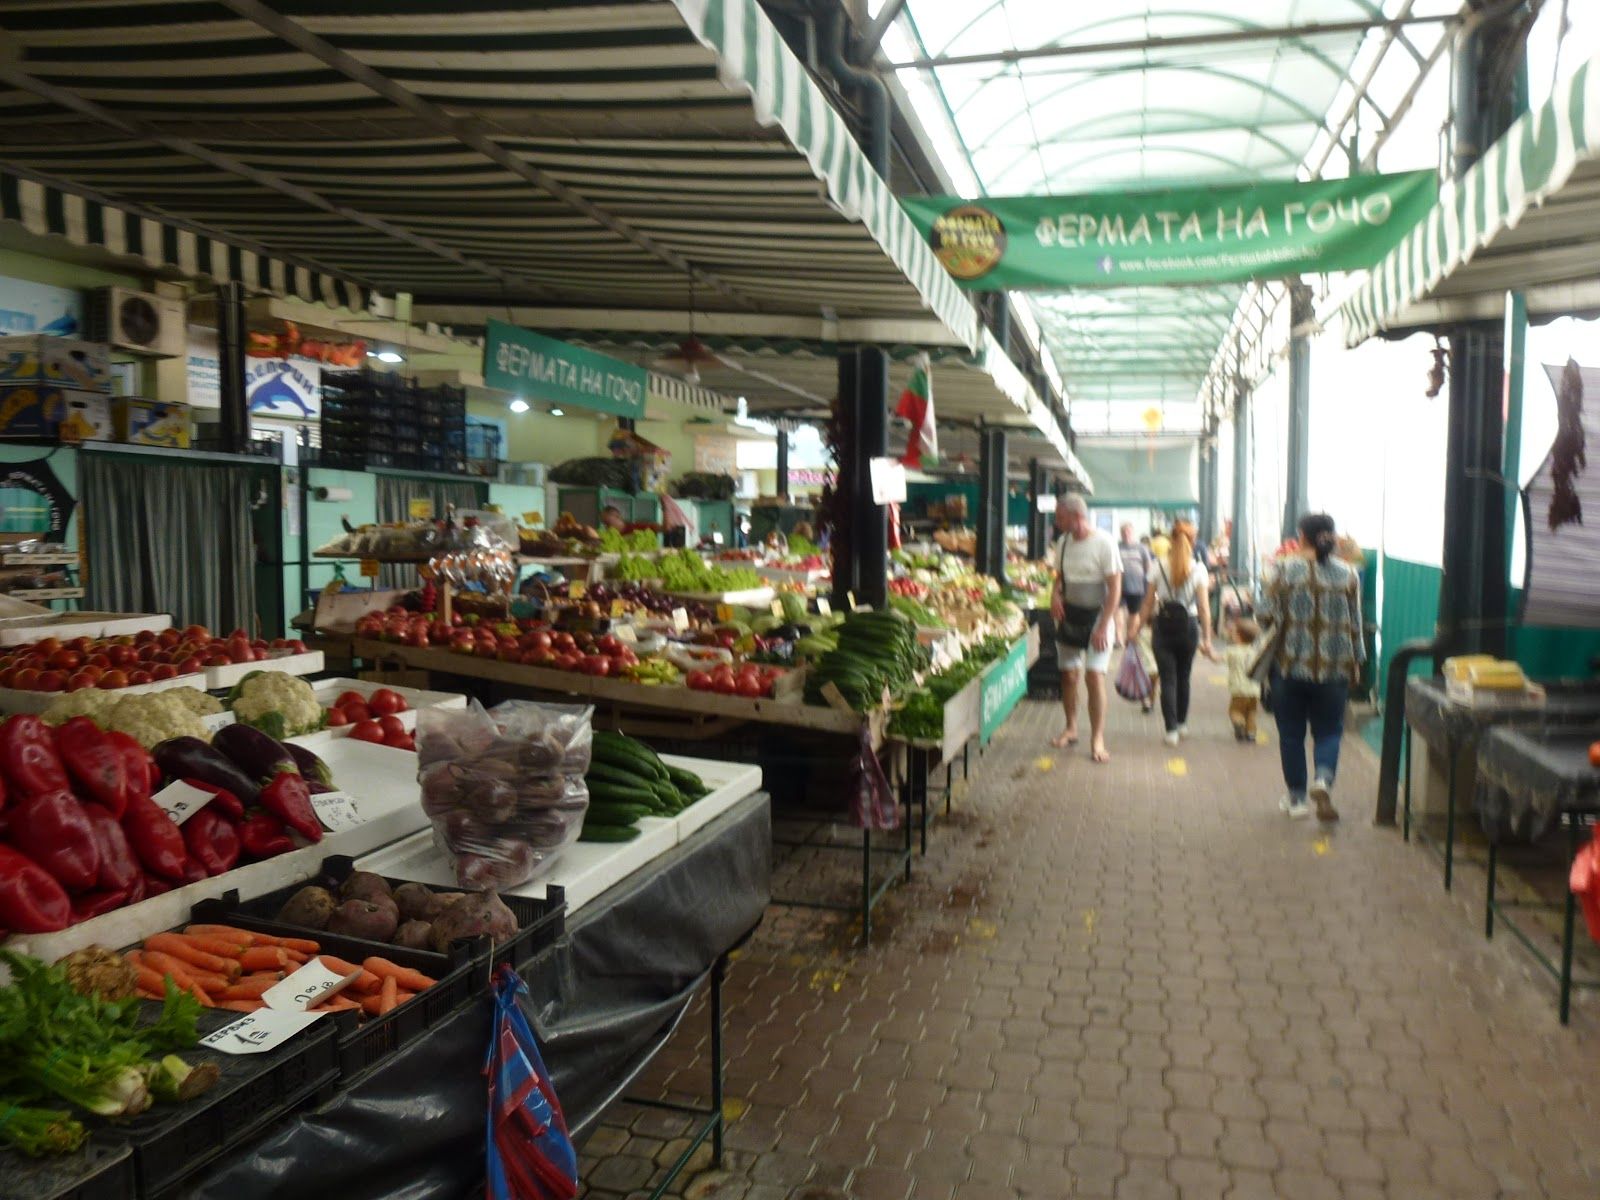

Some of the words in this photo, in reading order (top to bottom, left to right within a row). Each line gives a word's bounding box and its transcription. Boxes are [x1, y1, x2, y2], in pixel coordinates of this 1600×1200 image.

[1035, 211, 1204, 248] ФЕРМАТА
[1216, 204, 1270, 242] НА
[1284, 191, 1392, 237] ГОЧО
[495, 342, 578, 389] ФЕРМАТА
[580, 365, 603, 395] НА
[605, 372, 642, 406] ГОЧО
